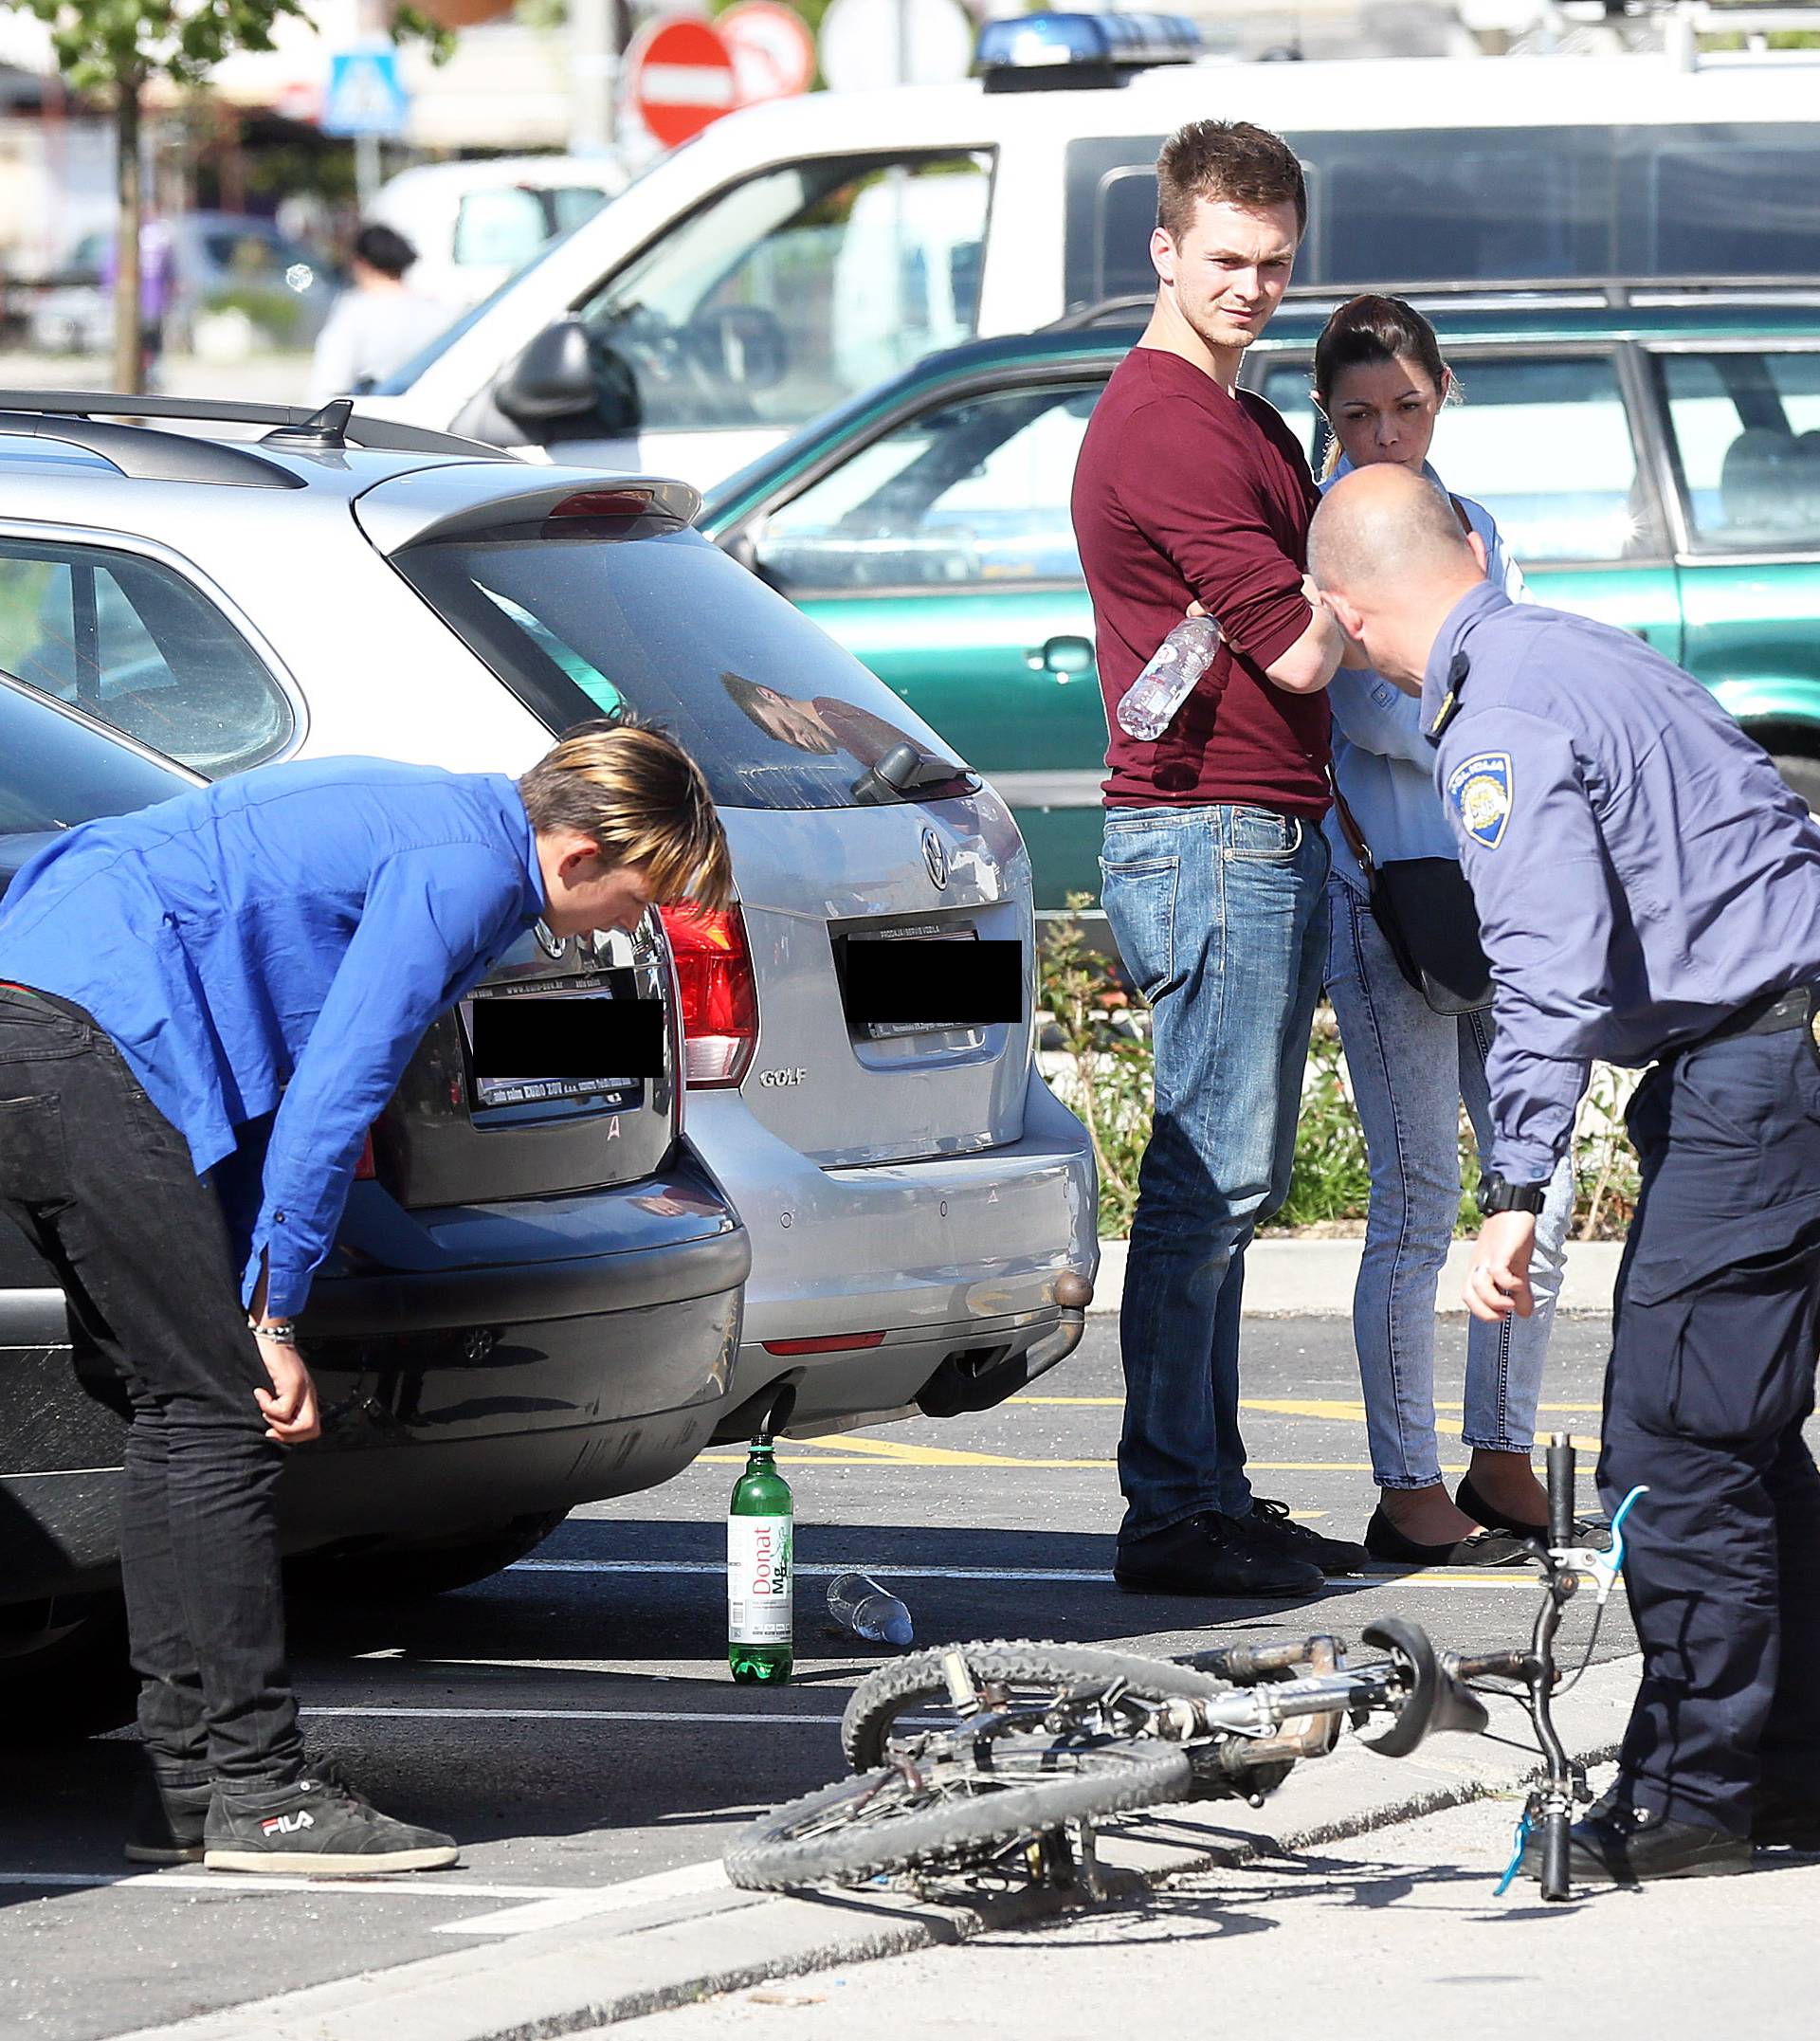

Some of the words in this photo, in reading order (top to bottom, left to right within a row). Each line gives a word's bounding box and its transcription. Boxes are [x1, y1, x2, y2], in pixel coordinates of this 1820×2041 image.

[523, 1084, 546, 1099] EURO
[545, 1082, 562, 1096] ZOV
[759, 1067, 807, 1087] GOLF
[753, 1526, 771, 1595] Donat
[773, 1567, 788, 1595] Mg
[262, 1810, 315, 1837] FILA
